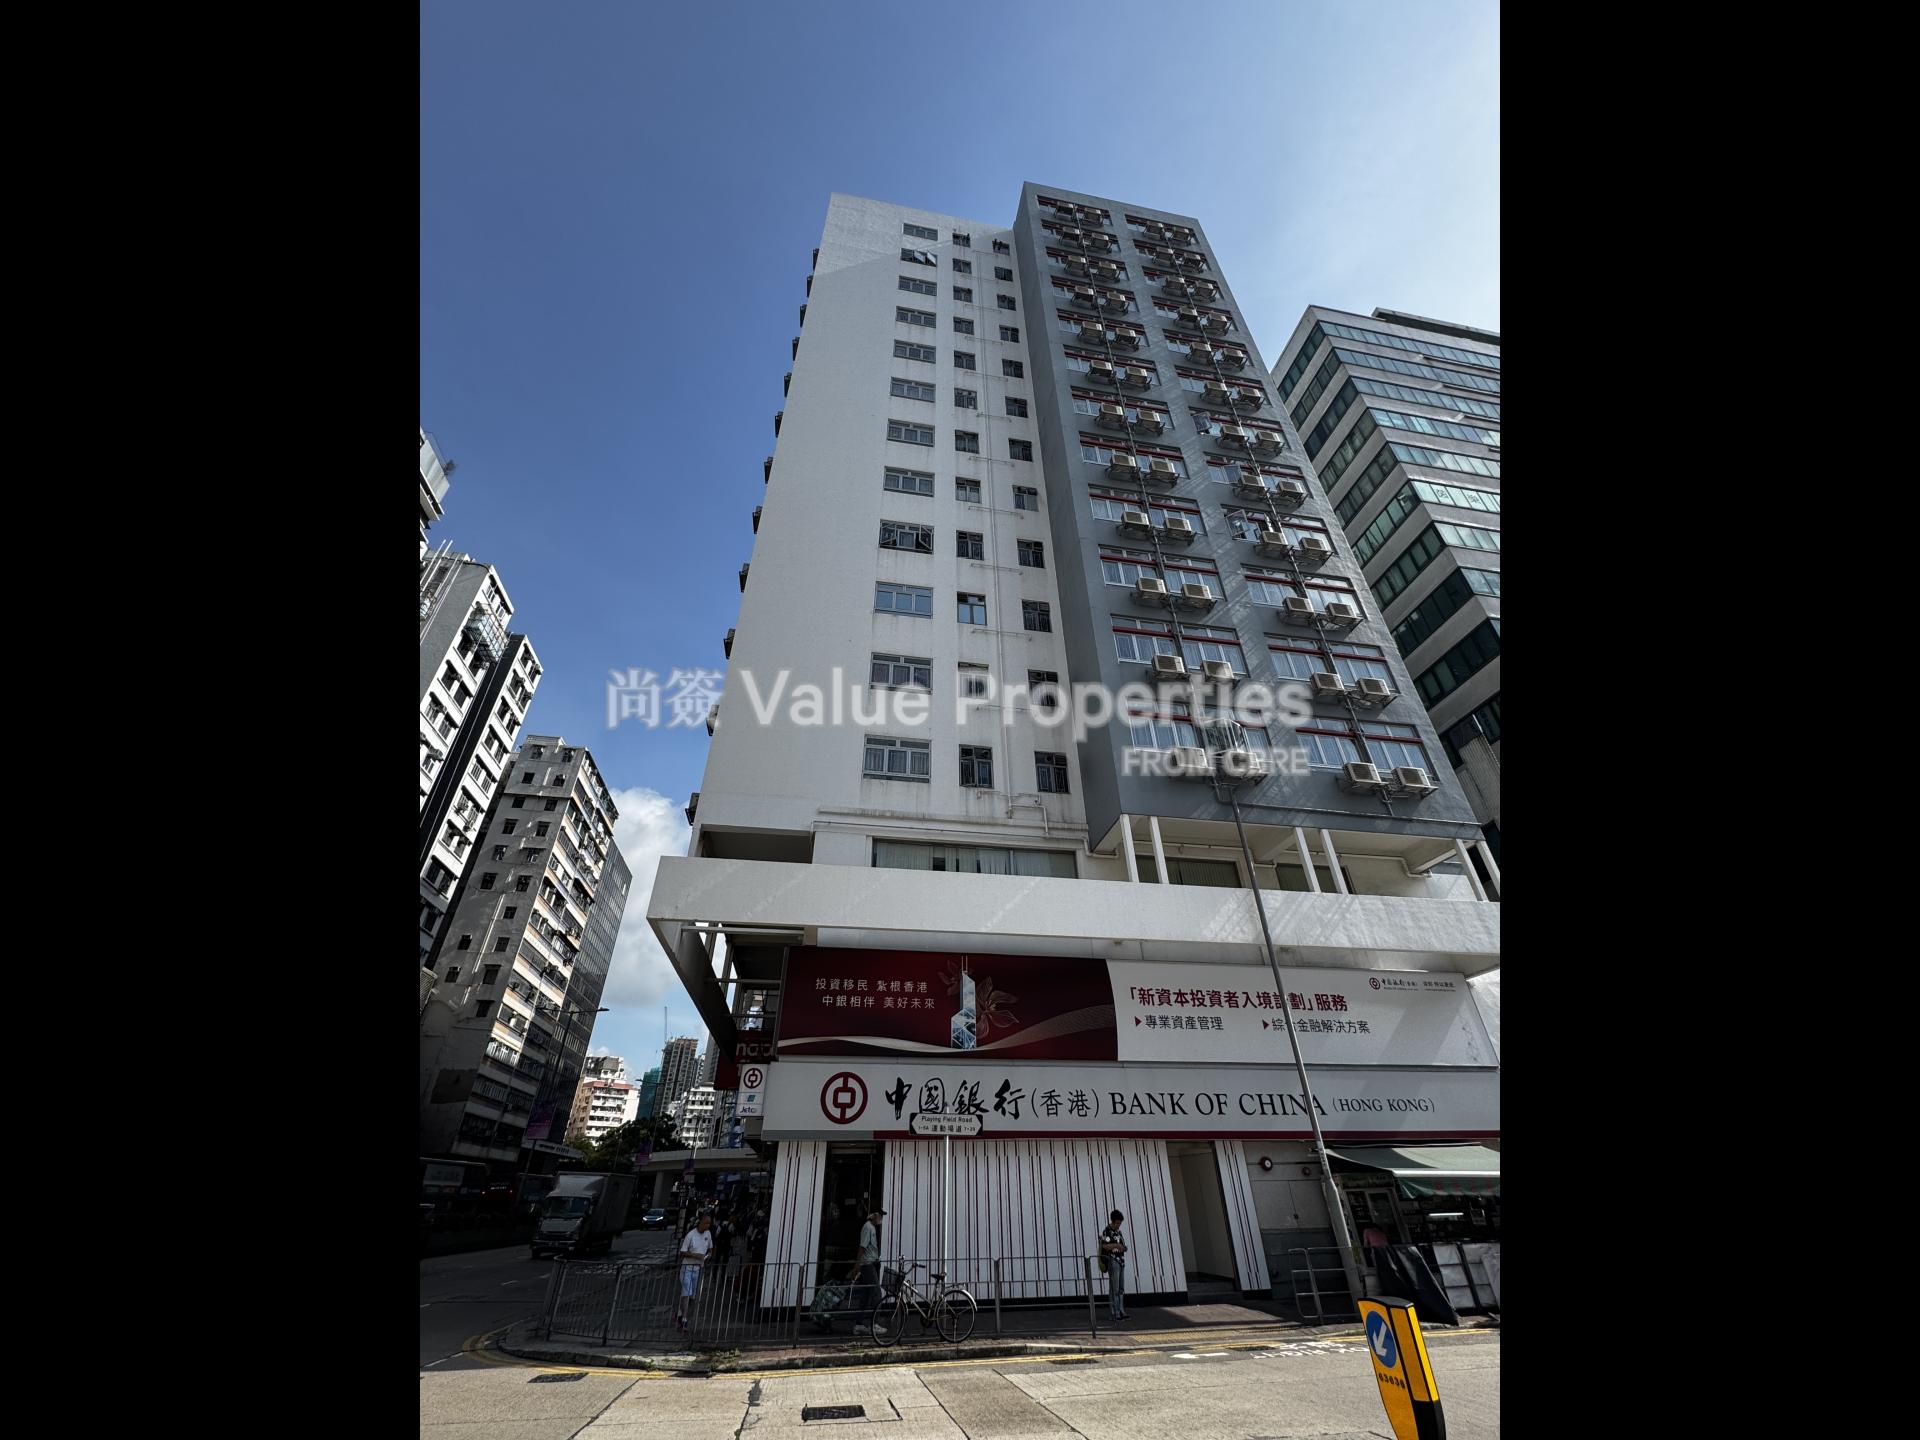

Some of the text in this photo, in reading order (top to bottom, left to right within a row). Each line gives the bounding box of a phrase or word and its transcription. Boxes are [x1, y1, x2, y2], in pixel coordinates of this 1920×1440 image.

[815, 977, 928, 993] 投資移民 紮根香港
[822, 994, 935, 1009] 中銀相伴 美好未來
[1145, 1014, 1225, 1031] 專業資產管理
[1110, 1091, 1436, 1116] BANK OF CHINA (HONG KONG)
[921, 1115, 941, 1123] Playing
[931, 1124, 962, 1133] 運動場道
